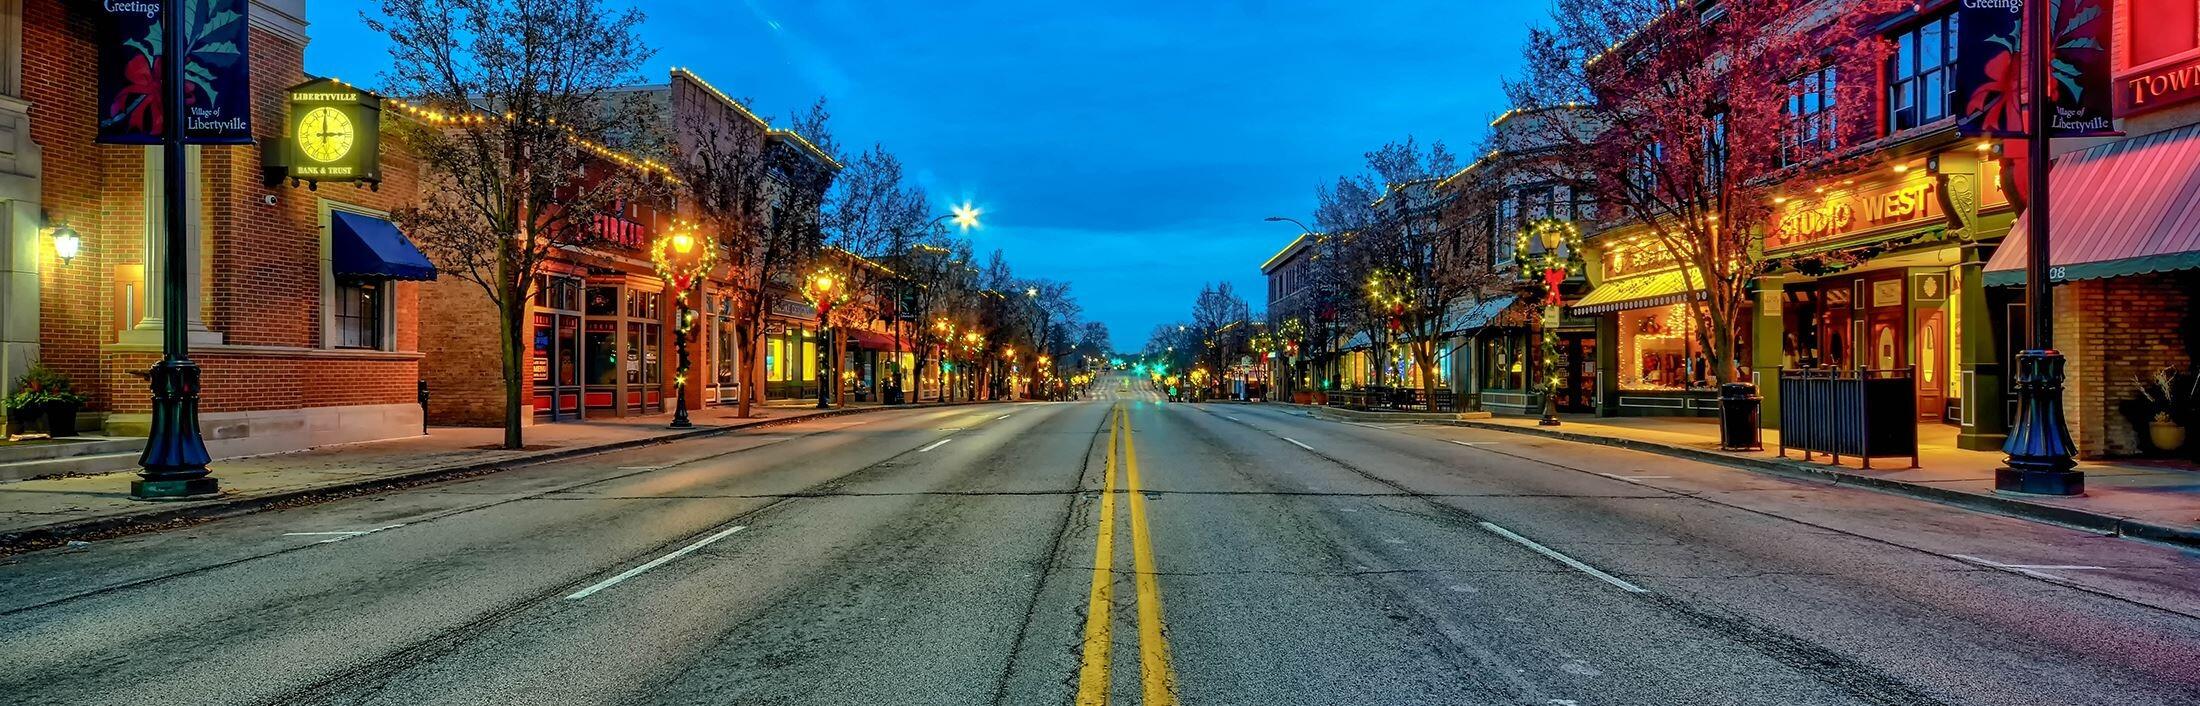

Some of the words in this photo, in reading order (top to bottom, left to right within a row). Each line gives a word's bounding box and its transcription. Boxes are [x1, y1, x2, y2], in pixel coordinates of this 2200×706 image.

[103, 0, 160, 18] Greetings
[1964, 0, 2023, 13] Greetings
[293, 93, 357, 101] LIBERTYVILLE
[191, 106, 212, 118] Village
[212, 106, 220, 117] of
[2076, 106, 2085, 117] of
[188, 116, 247, 134] Libertyville
[2051, 115, 2109, 133] Libertyville
[297, 166, 319, 175] BANK
[320, 166, 326, 175] &
[328, 167, 352, 175] TRUST
[1778, 203, 1850, 239] STUDIO
[1863, 182, 1929, 222] WEST
